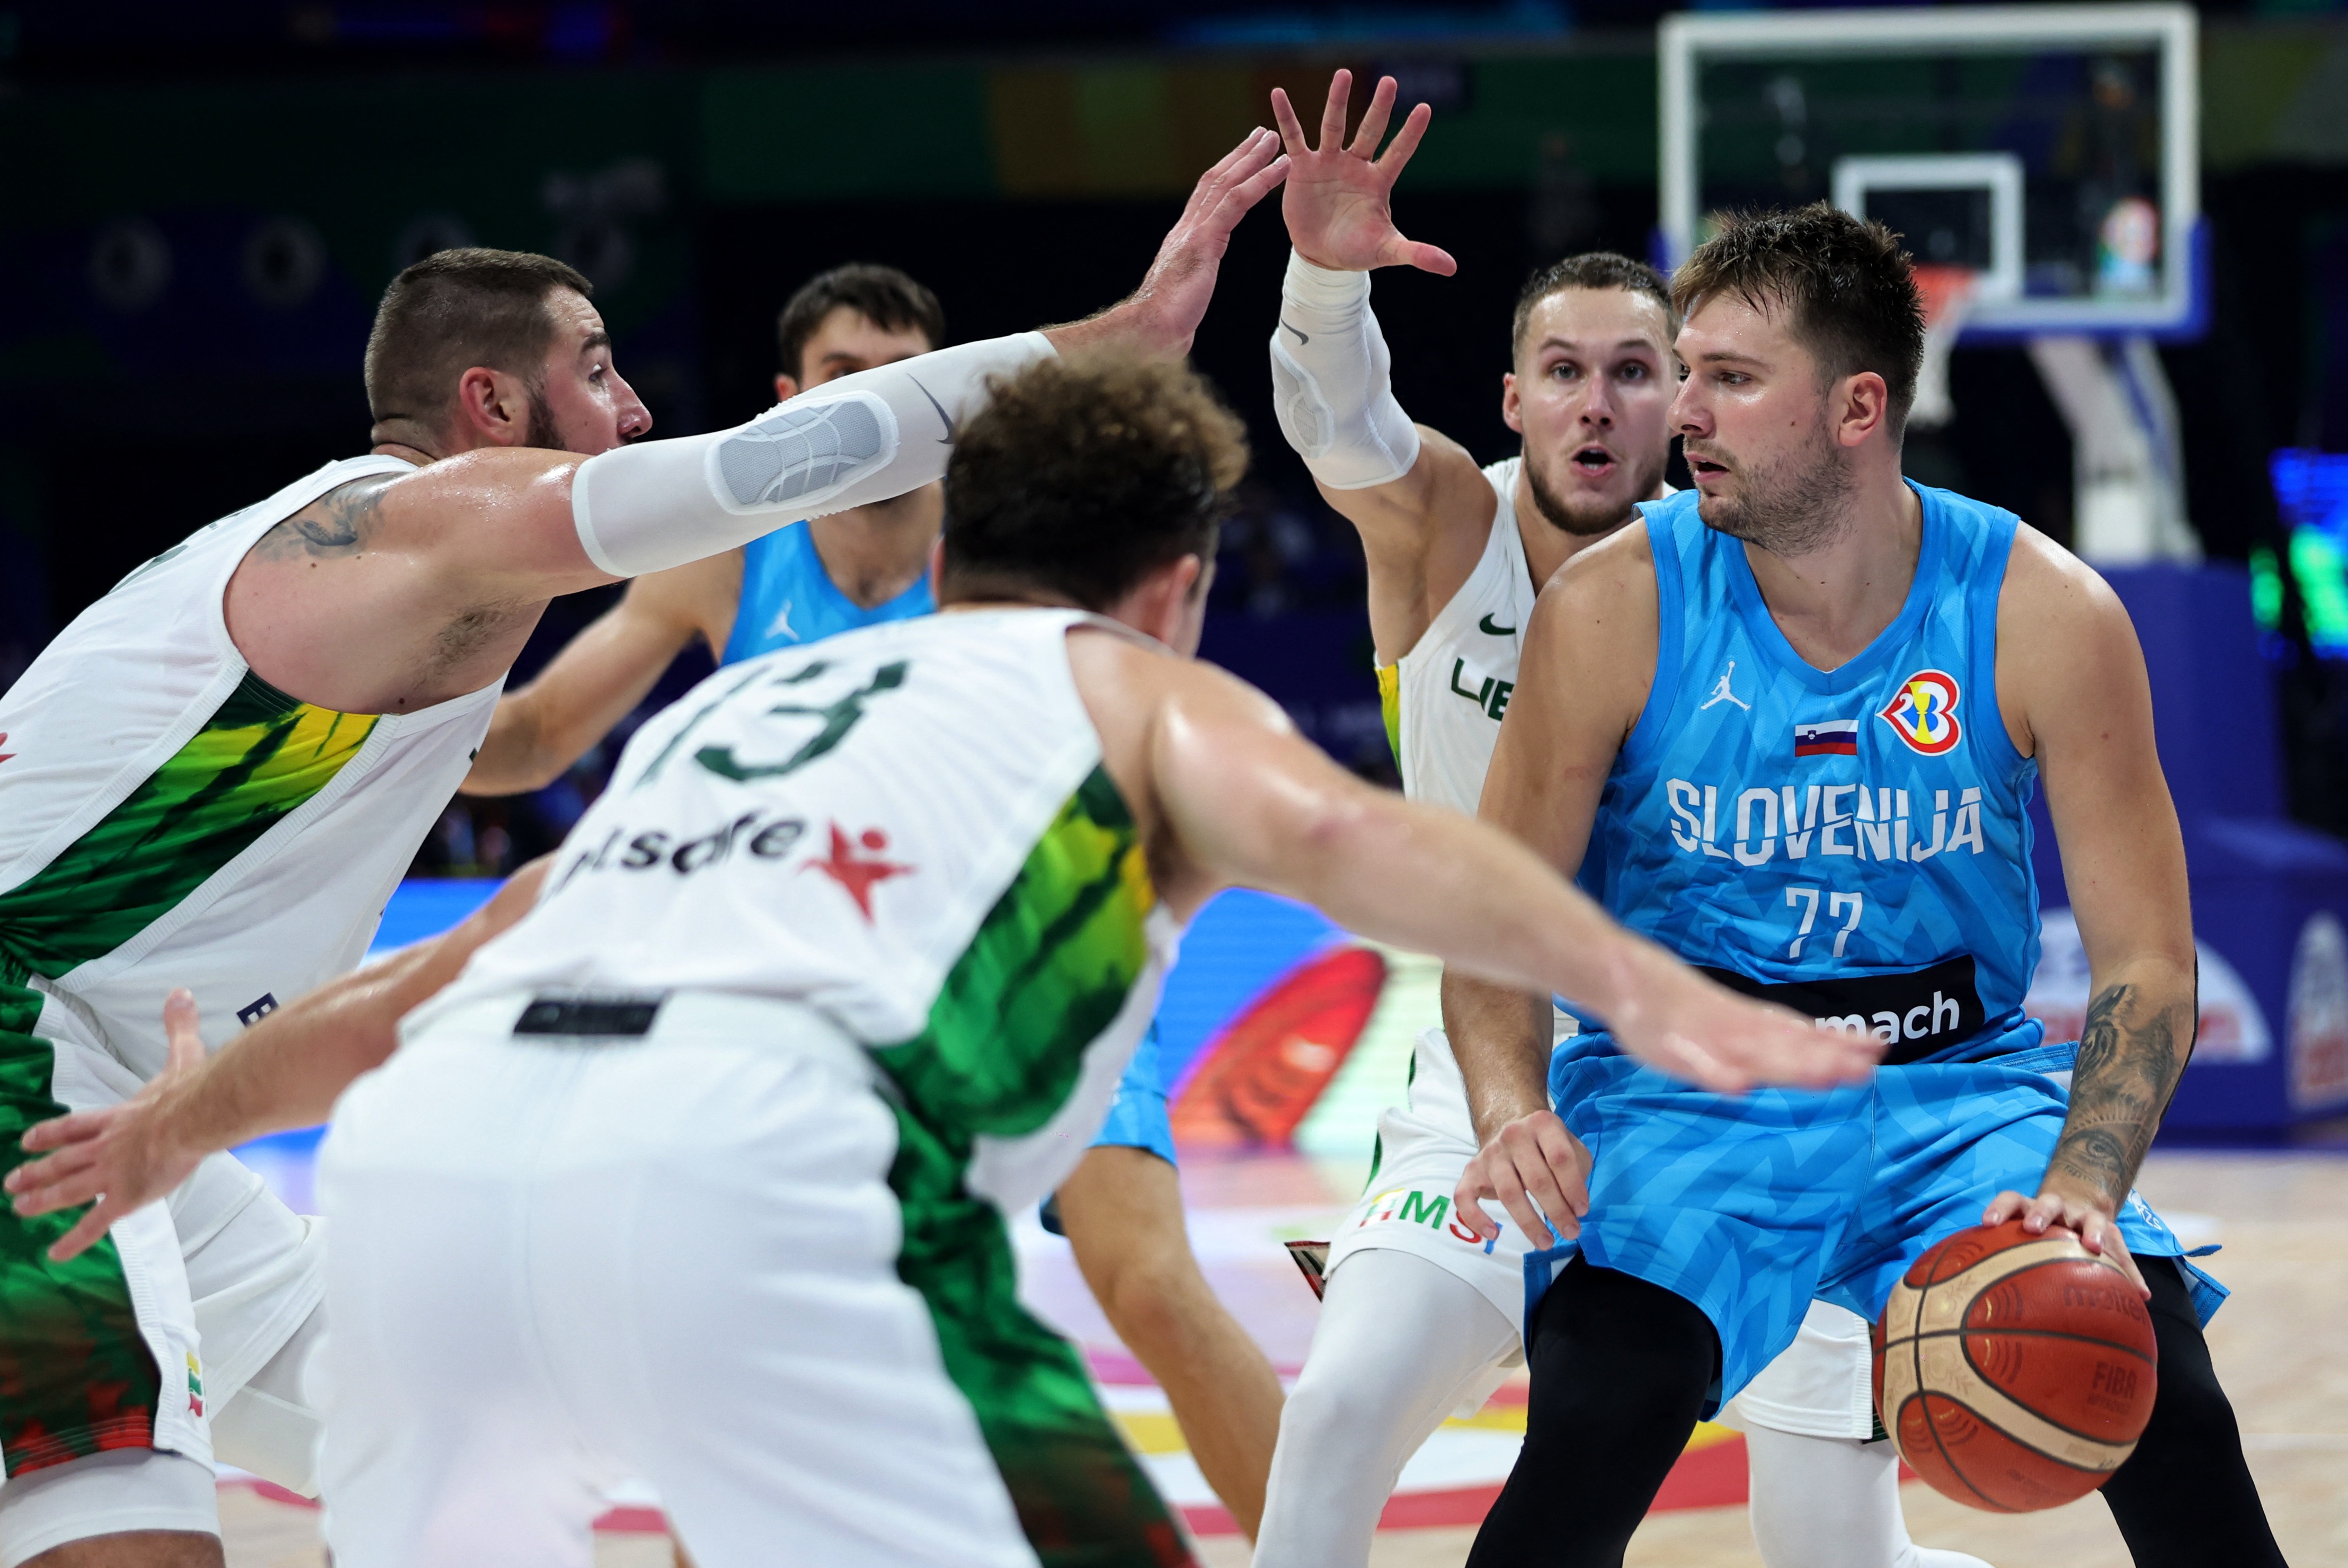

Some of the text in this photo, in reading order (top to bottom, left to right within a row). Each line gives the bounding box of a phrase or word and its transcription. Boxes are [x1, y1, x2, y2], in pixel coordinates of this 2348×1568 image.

[549, 807, 806, 896] safe
[1666, 778, 1984, 867] SLOVENIJA
[1785, 887, 1863, 959] 77
[1793, 990, 1960, 1047] mach
[2092, 1360, 2138, 1401] FIBA
